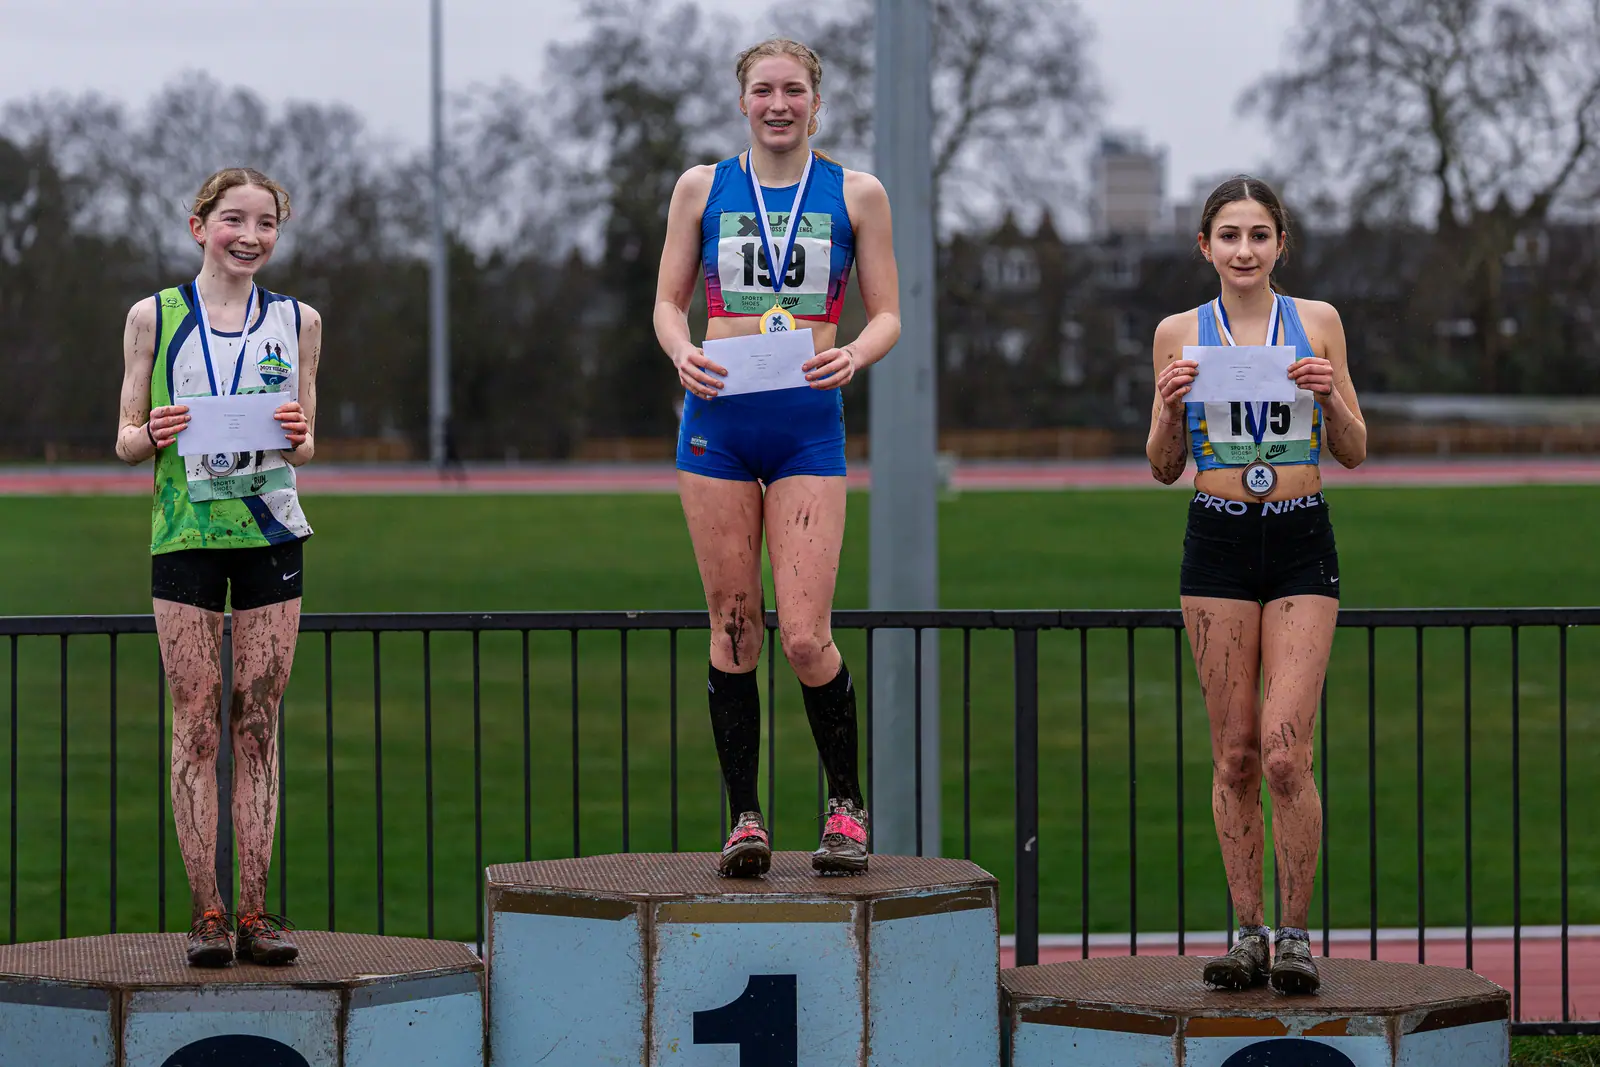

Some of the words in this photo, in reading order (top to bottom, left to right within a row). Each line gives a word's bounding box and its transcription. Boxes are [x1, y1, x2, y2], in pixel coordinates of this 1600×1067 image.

[742, 243, 806, 287] 199
[782, 297, 800, 305] RUN
[1269, 444, 1287, 453] RUN
[253, 475, 267, 485] RUN
[1194, 492, 1248, 515] PRO
[1261, 495, 1319, 517] NIKE
[693, 974, 797, 1067] 1
